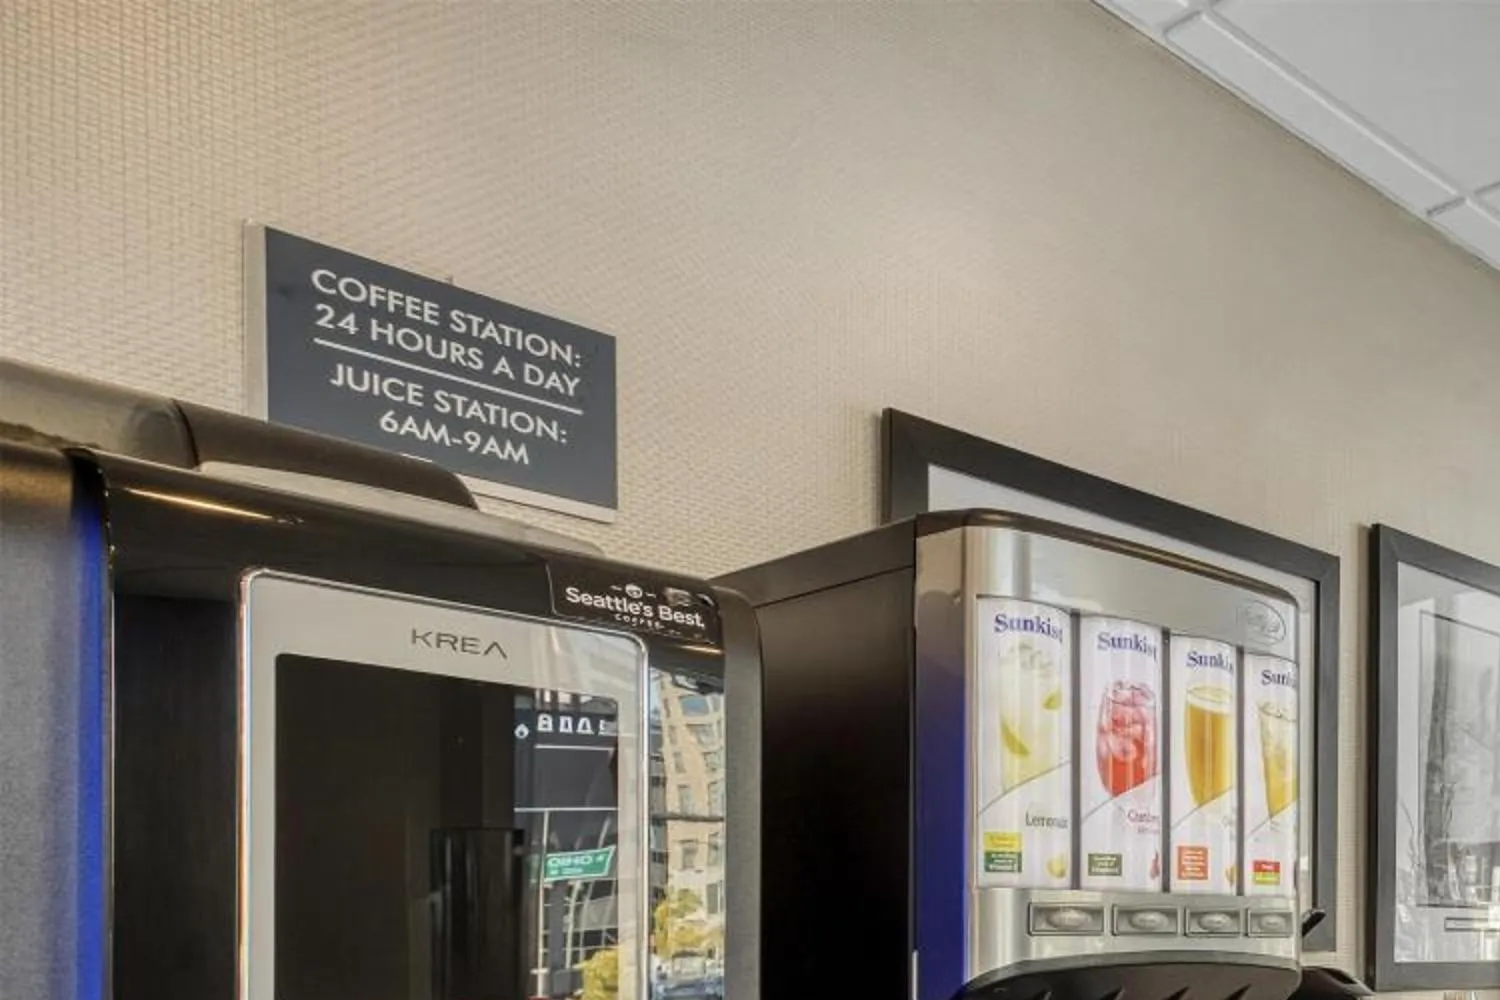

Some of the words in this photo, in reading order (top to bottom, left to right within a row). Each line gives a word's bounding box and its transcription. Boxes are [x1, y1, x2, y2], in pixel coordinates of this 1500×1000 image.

[310, 268, 440, 327] COFFEE
[449, 309, 583, 369] STATION:
[314, 303, 360, 336] 24
[370, 319, 485, 371] HOURS
[492, 356, 516, 380] A
[523, 363, 582, 398] DAY
[329, 363, 424, 408] JUICE
[433, 389, 568, 444] STATION:
[379, 410, 530, 465] 6AM-9AM
[565, 586, 654, 617] Seattle's
[994, 613, 1063, 643] Sunkist
[410, 628, 508, 660] KREA
